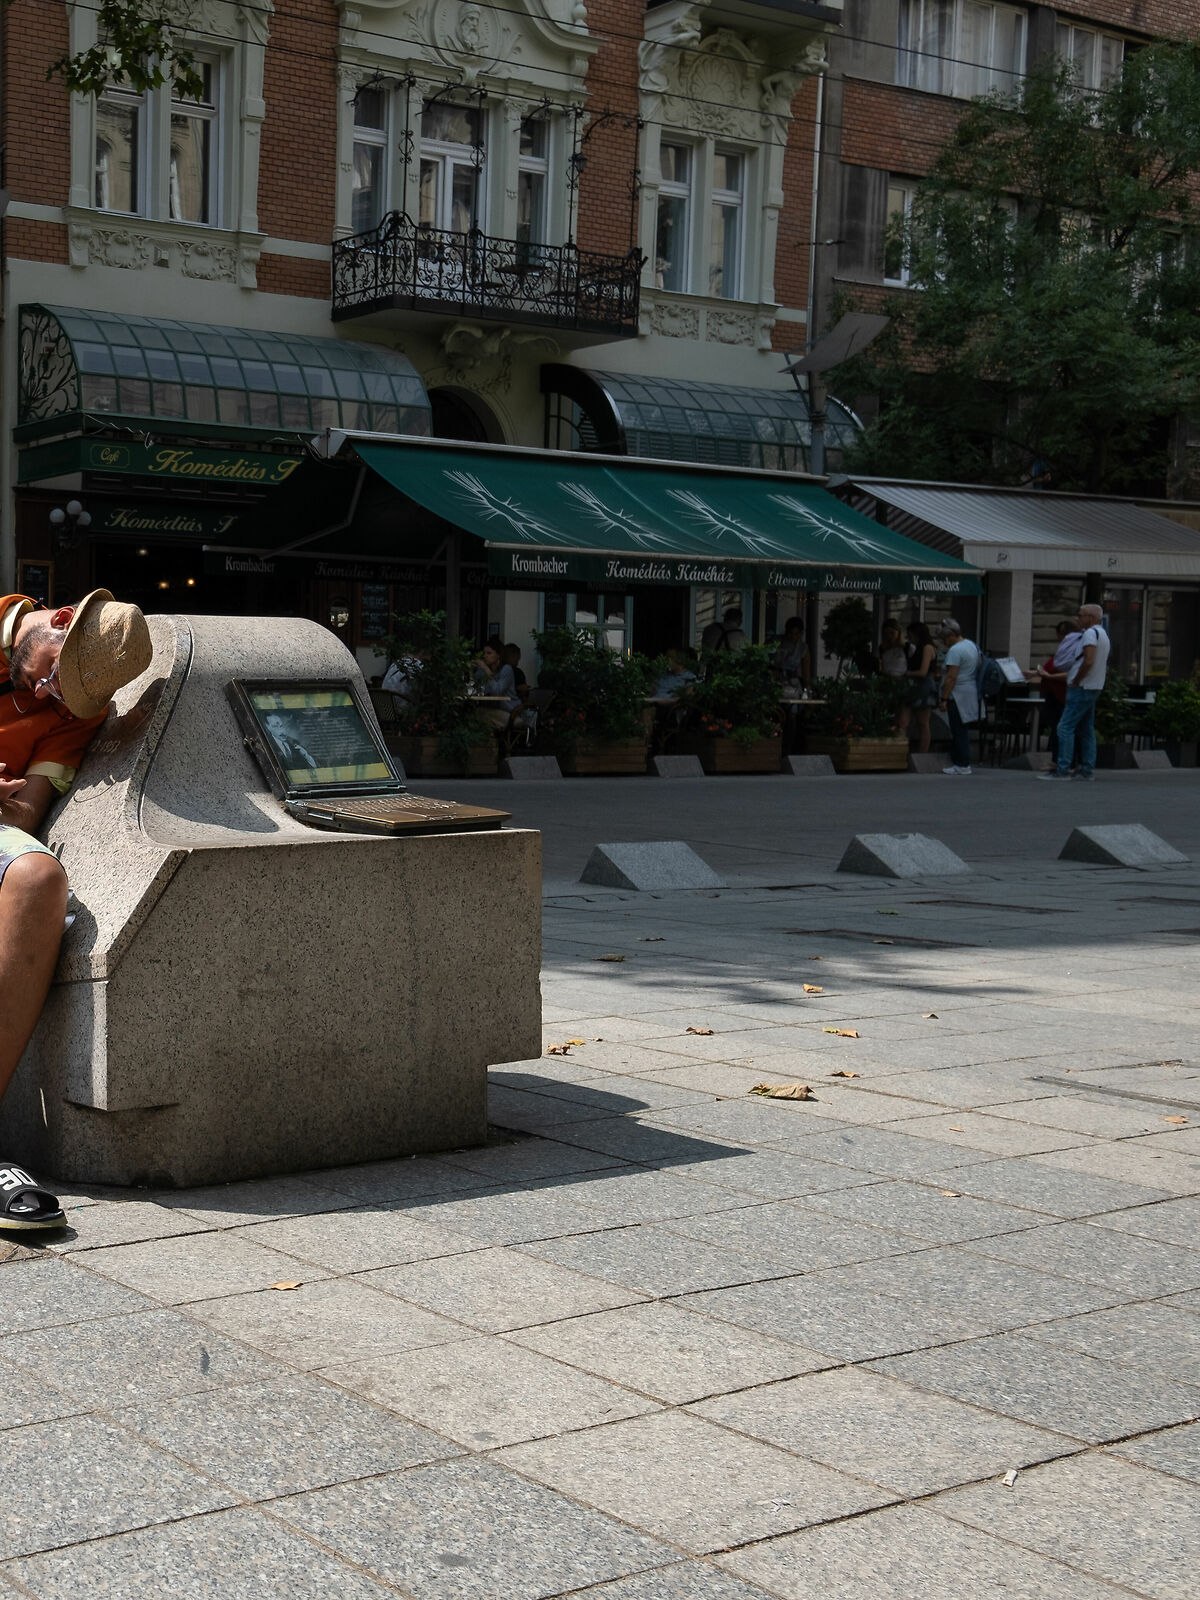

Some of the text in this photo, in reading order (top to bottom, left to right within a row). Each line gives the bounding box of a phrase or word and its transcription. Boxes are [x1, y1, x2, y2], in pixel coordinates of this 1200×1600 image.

[148, 449, 267, 480] Komédiás
[104, 507, 203, 532] Komédiás
[225, 554, 275, 574] Krombacher
[512, 553, 568, 574] Krombacher
[605, 560, 734, 583] Komédiás Kávéház
[824, 573, 882, 591] Restaurant
[913, 575, 960, 592] Krombacher
